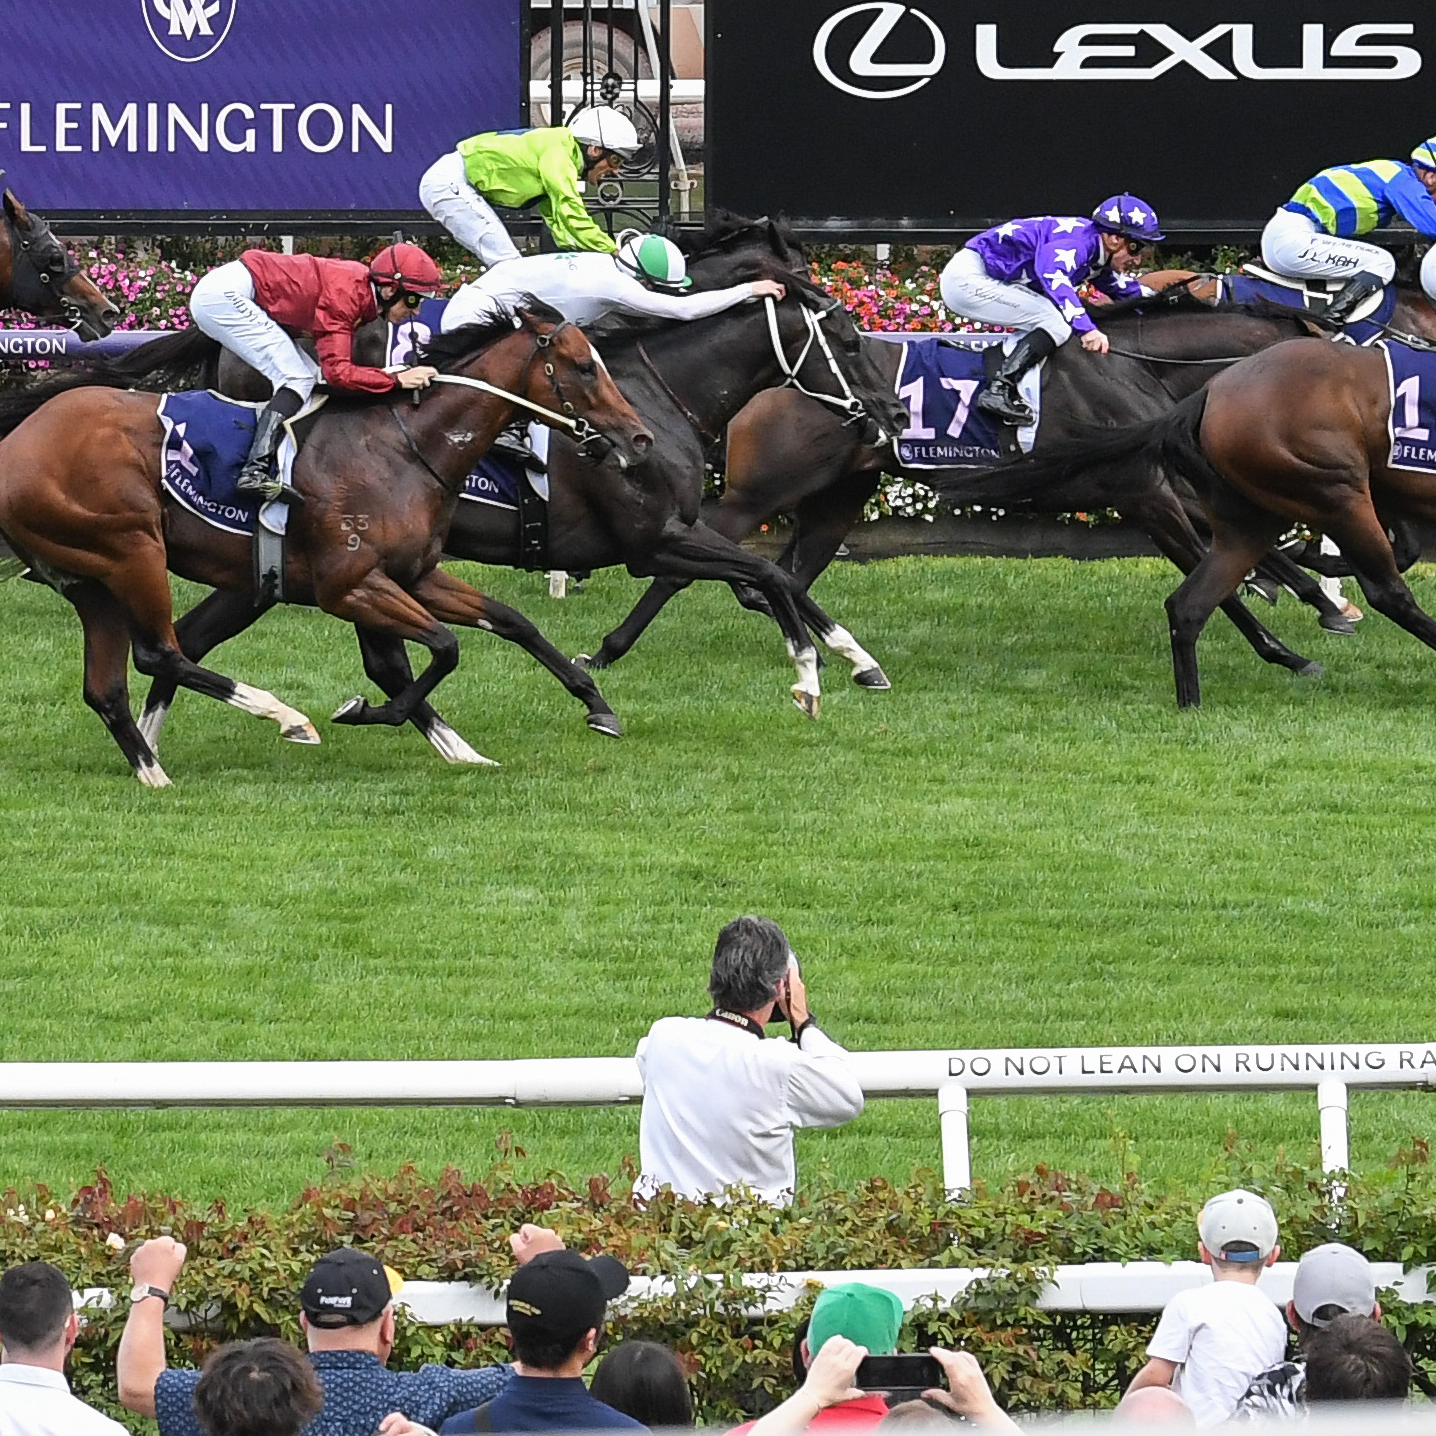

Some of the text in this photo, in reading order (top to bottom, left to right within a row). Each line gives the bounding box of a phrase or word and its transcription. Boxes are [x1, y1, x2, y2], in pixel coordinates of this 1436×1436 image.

[975, 23, 1423, 81] LEXUS
[899, 375, 980, 440] 17
[914, 445, 1001, 459] FLEMINGTON
[346, 533, 361, 552] 9
[715, 1008, 749, 1027] Canon
[947, 1056, 992, 1077] DO
[1004, 1054, 1067, 1076] NOT
[1079, 1053, 1162, 1075] LEAN
[1174, 1052, 1222, 1074] ON
[1234, 1050, 1386, 1073] RUNNING
